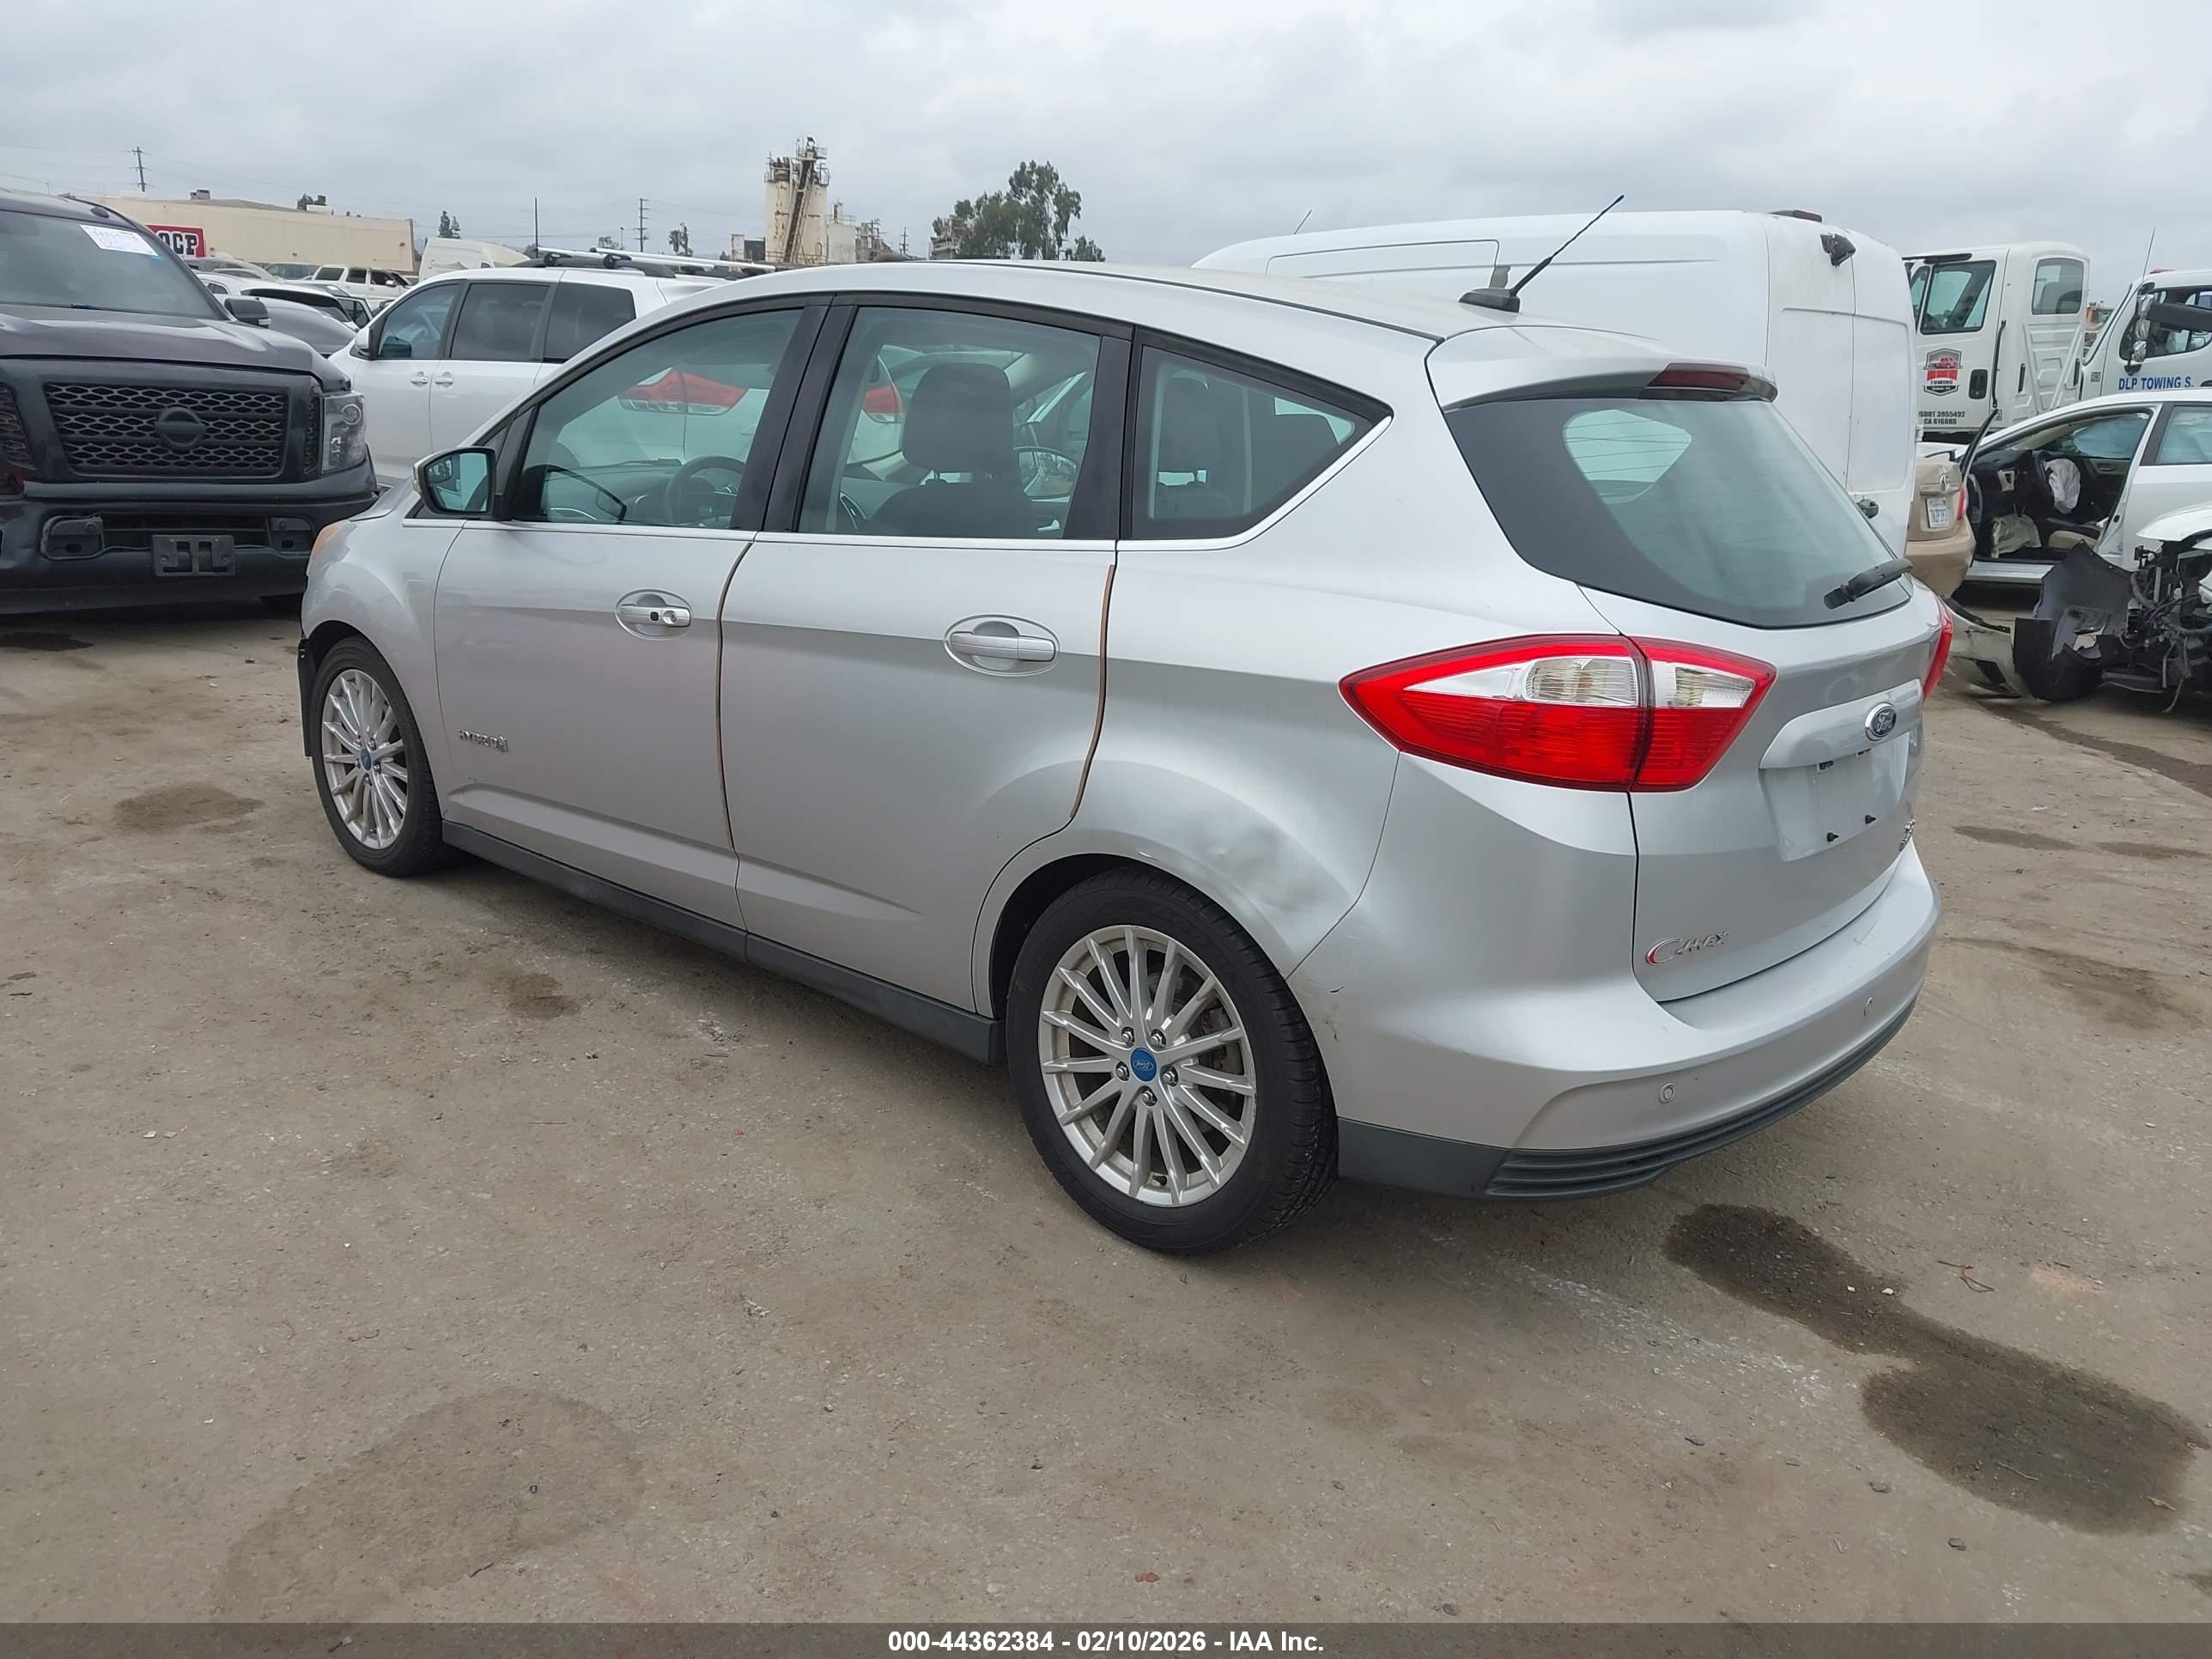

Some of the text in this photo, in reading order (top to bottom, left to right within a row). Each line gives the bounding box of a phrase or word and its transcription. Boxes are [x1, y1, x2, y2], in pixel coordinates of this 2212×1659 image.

[2118, 378, 2138, 390] DLP
[2141, 377, 2182, 390] TOWING
[1876, 711, 1894, 732] Ford
